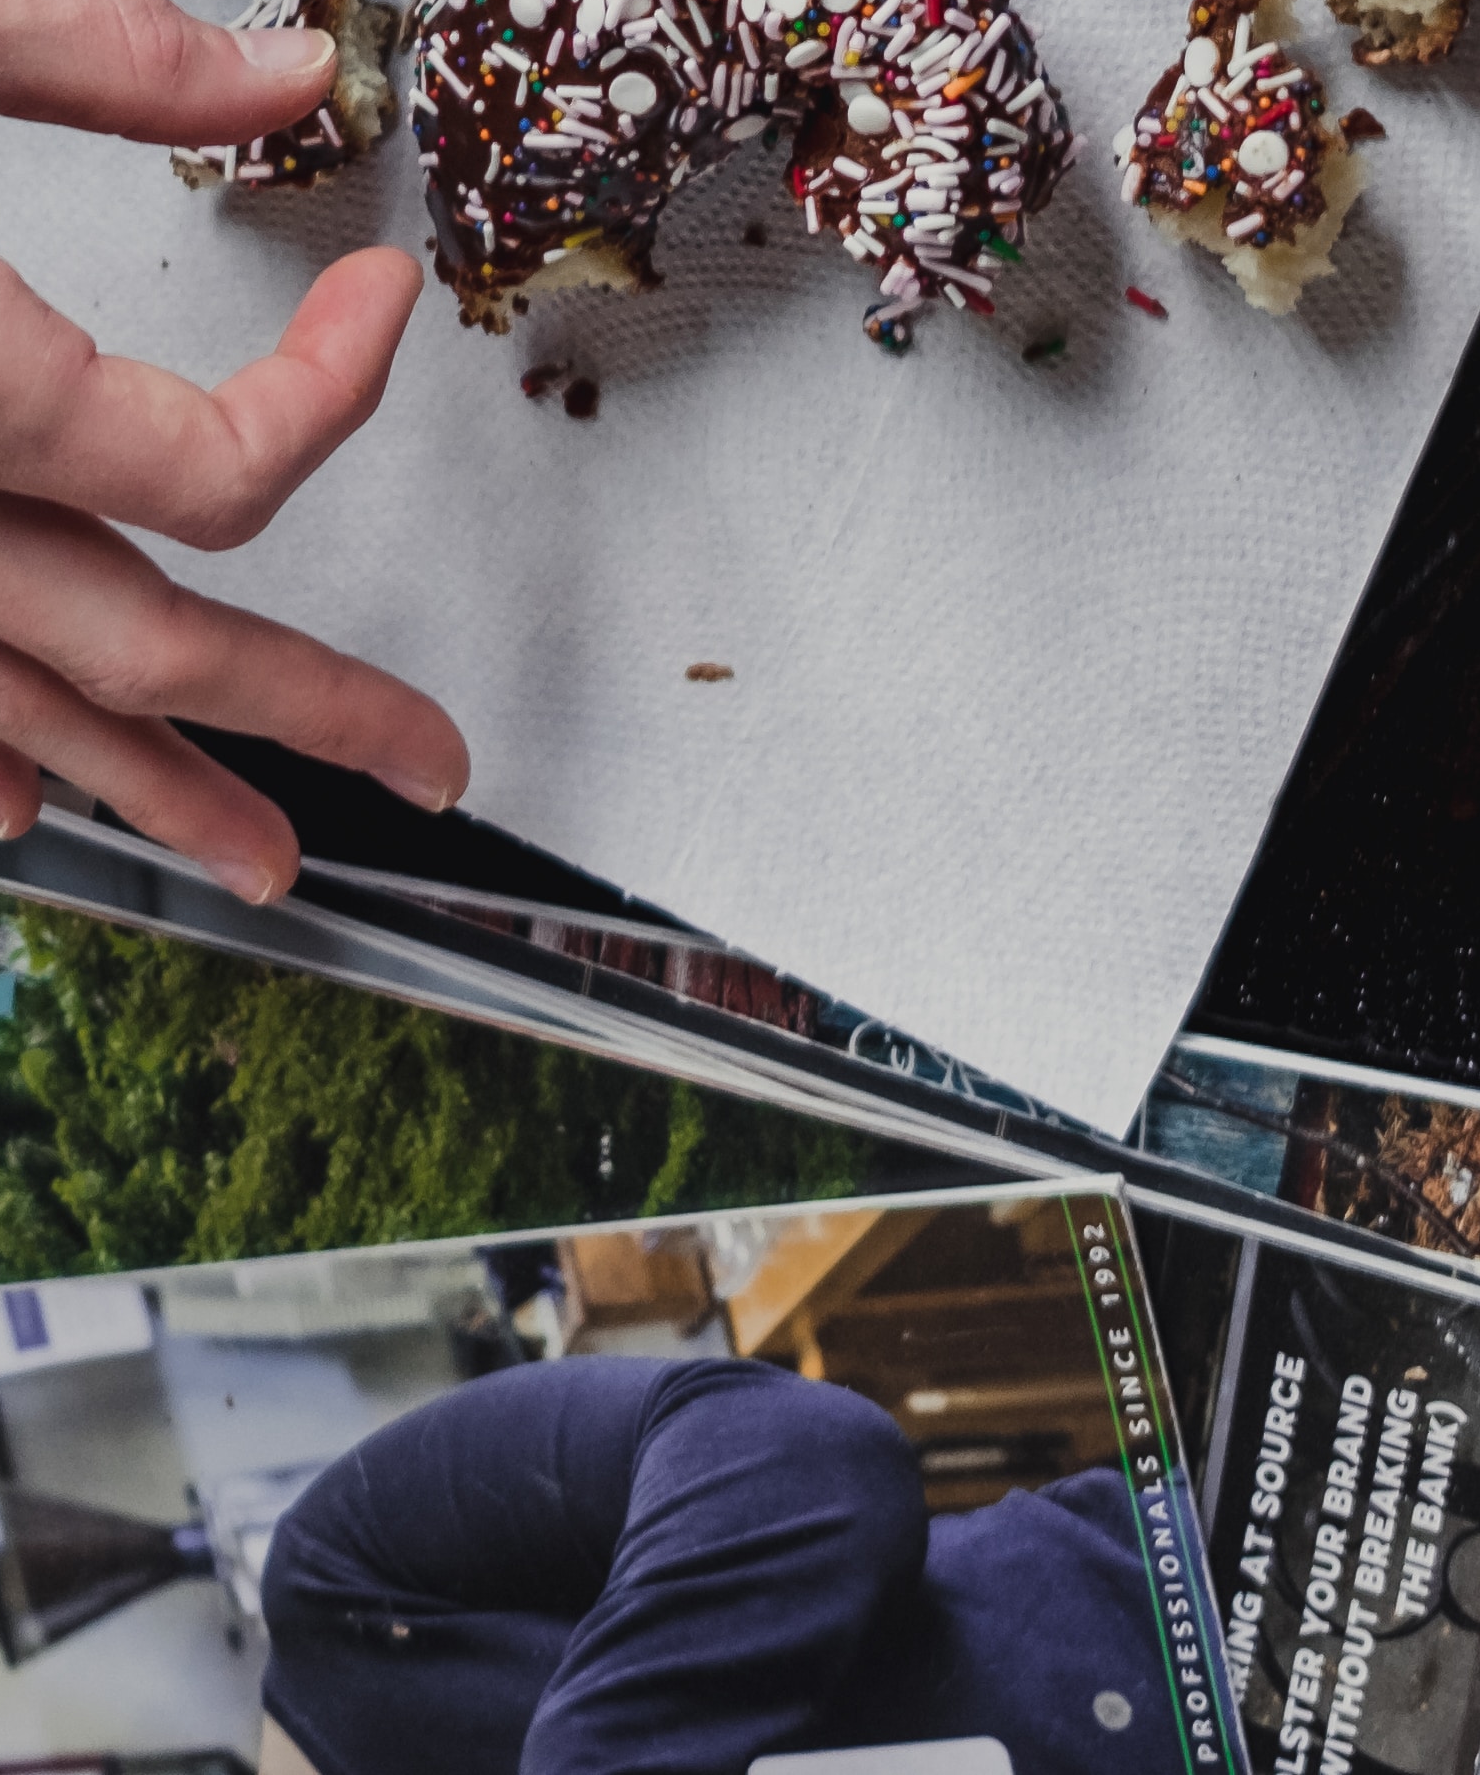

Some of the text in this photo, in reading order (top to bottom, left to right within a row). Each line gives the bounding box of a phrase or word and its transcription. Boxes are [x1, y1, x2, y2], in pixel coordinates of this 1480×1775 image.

[1083, 1222, 1219, 1764] PROFESSIONALS SINCE 1992
[1224, 1350, 1307, 1707] RING AT SOURCE
[1273, 1374, 1375, 1775] LSTER YOUR BRAND
[1318, 1387, 1419, 1775] WITHOUT BREAKING
[1395, 1399, 1470, 1620] THE BANK)
